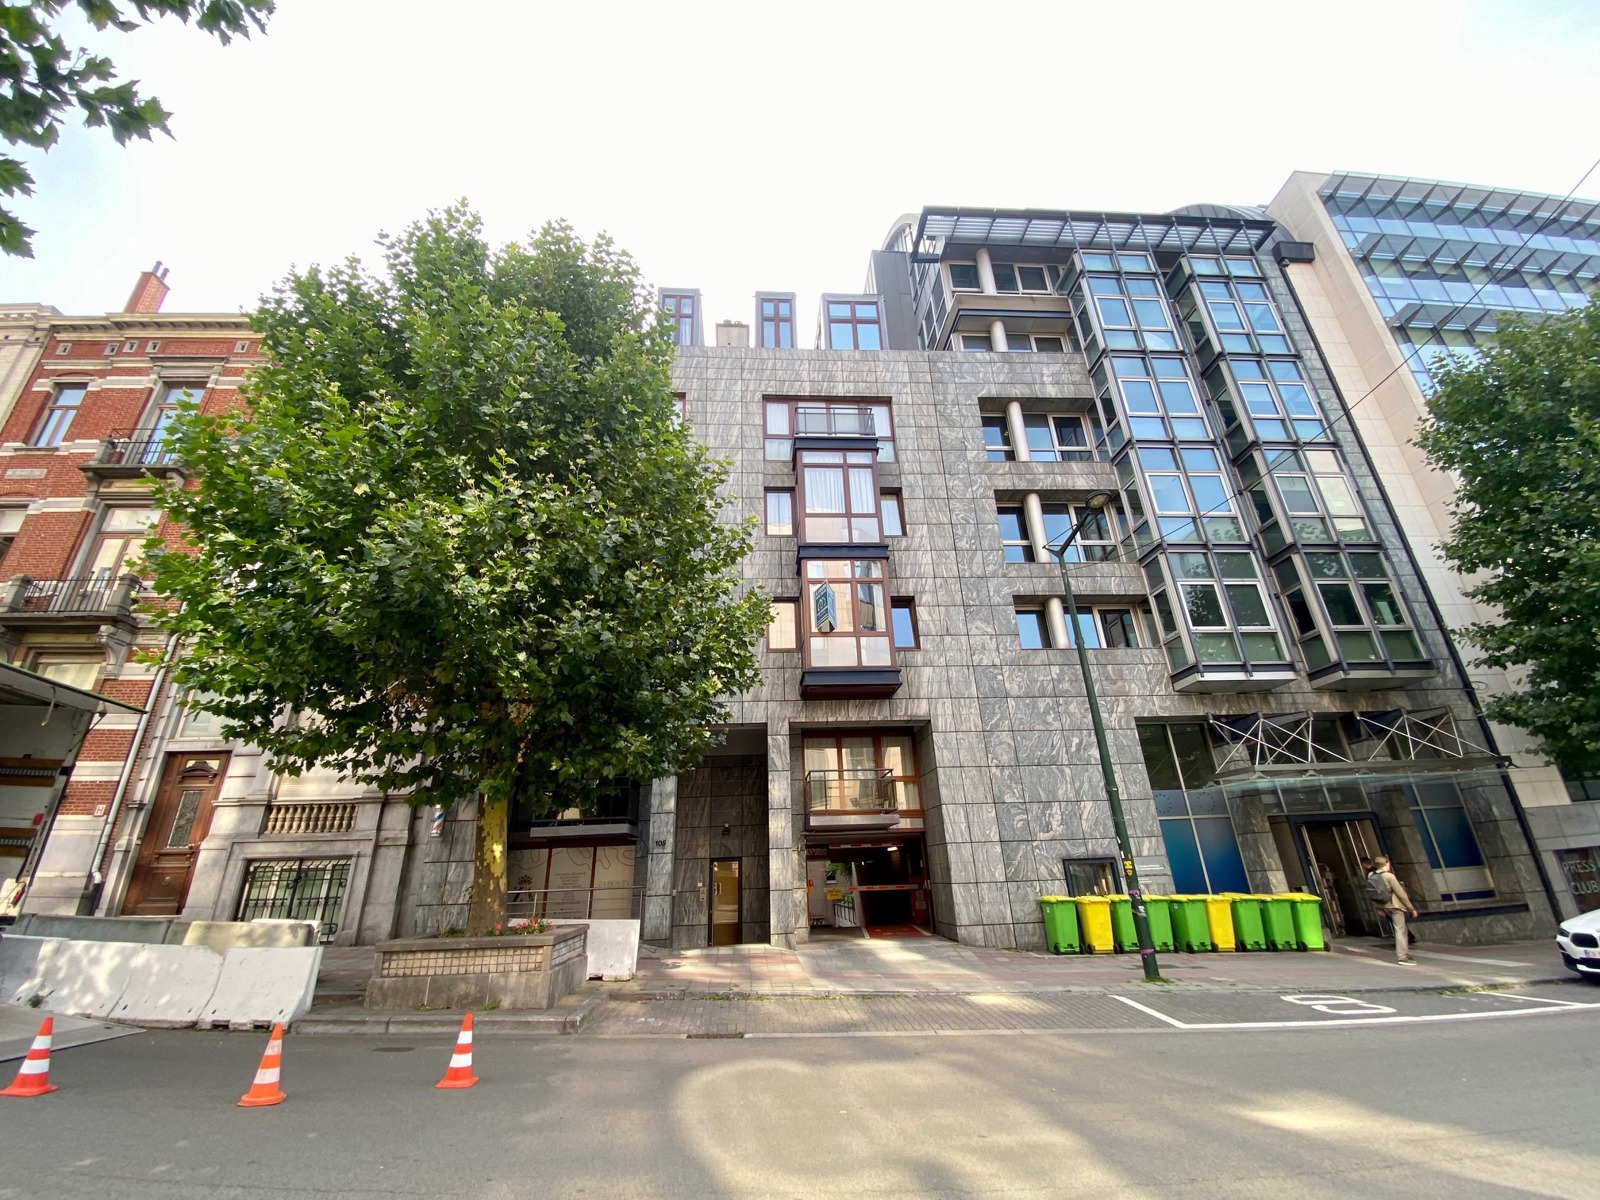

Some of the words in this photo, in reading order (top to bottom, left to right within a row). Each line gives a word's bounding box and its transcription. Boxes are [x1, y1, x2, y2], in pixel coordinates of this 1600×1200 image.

[655, 839, 666, 847] 105
[1561, 859, 1597, 874] PRESS
[1569, 880, 1600, 895] CLUB
